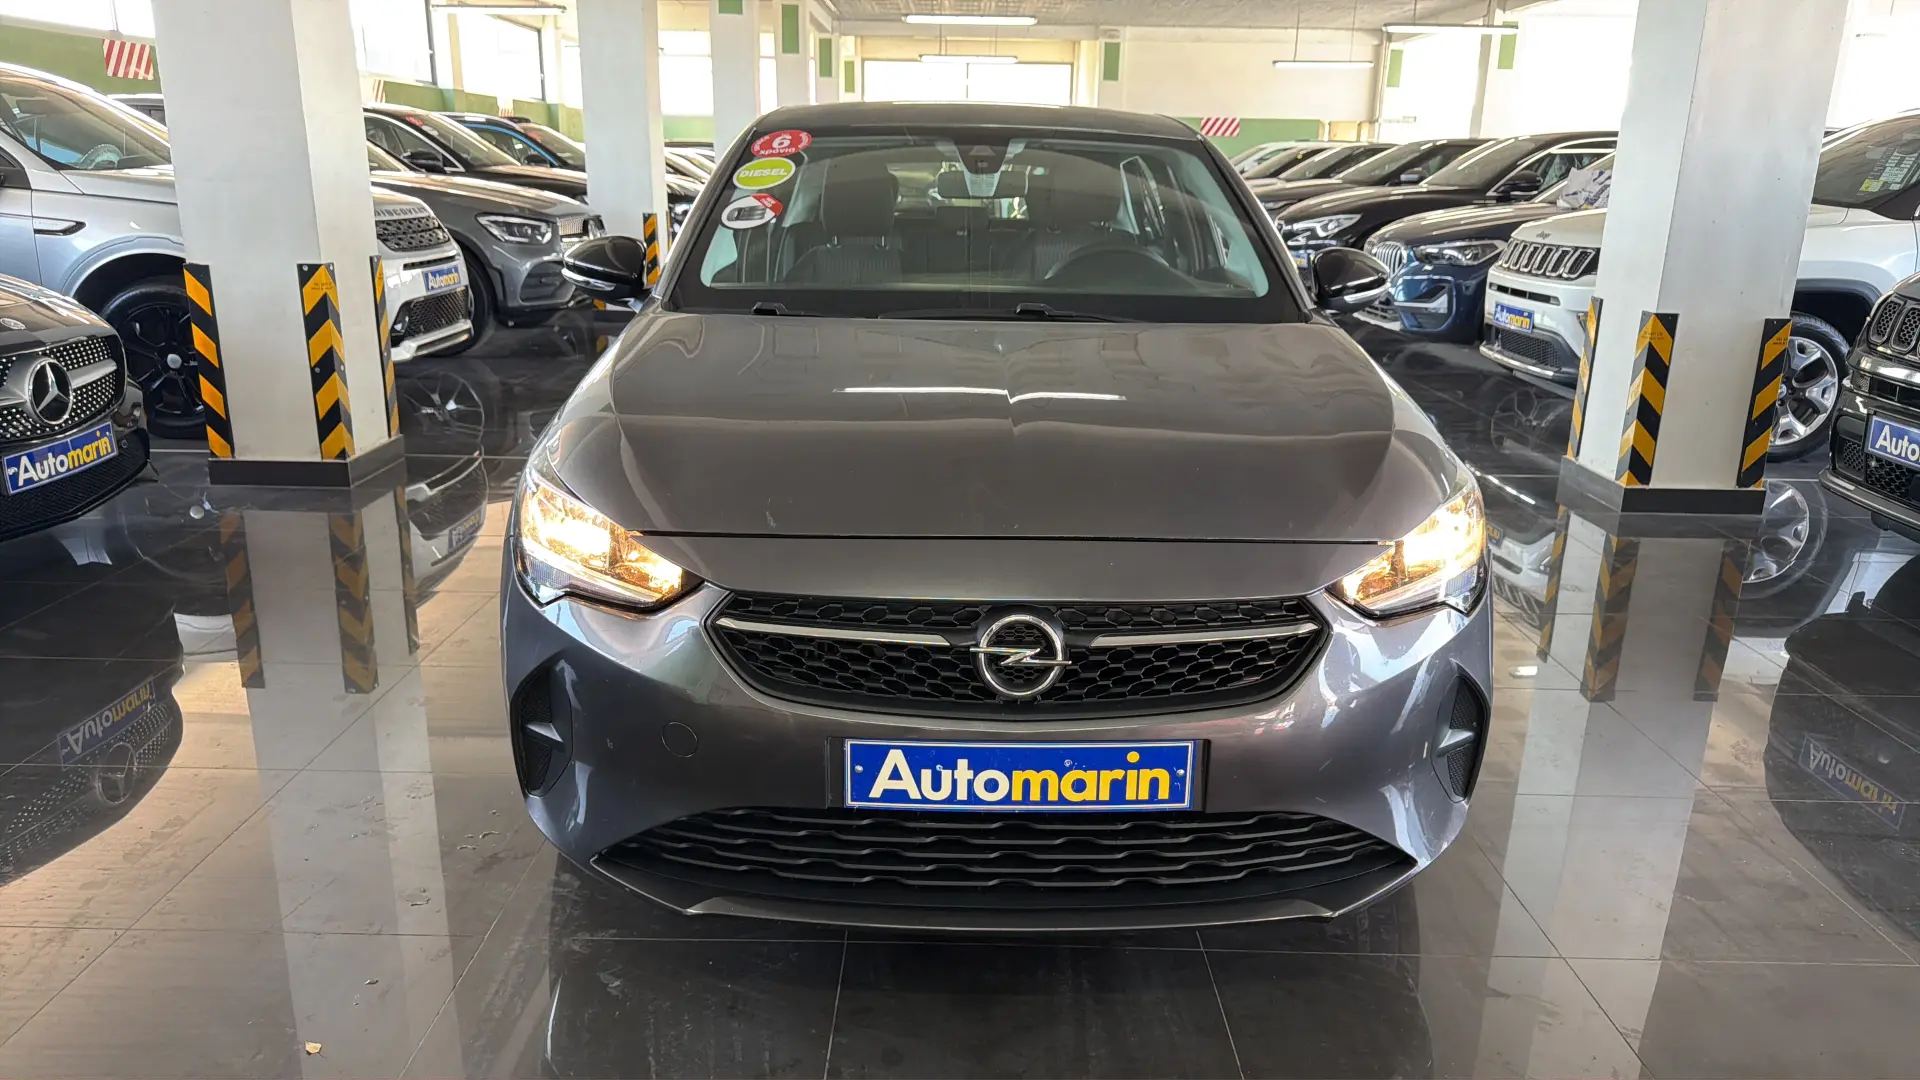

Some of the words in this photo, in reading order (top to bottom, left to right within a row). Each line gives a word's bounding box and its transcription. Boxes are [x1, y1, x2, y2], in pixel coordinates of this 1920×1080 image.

[772, 135, 792, 149] 6
[739, 167, 788, 178] DIESEL
[18, 430, 112, 487] Automarin
[1875, 424, 1920, 462] Auto
[868, 749, 1170, 802] Automarin
